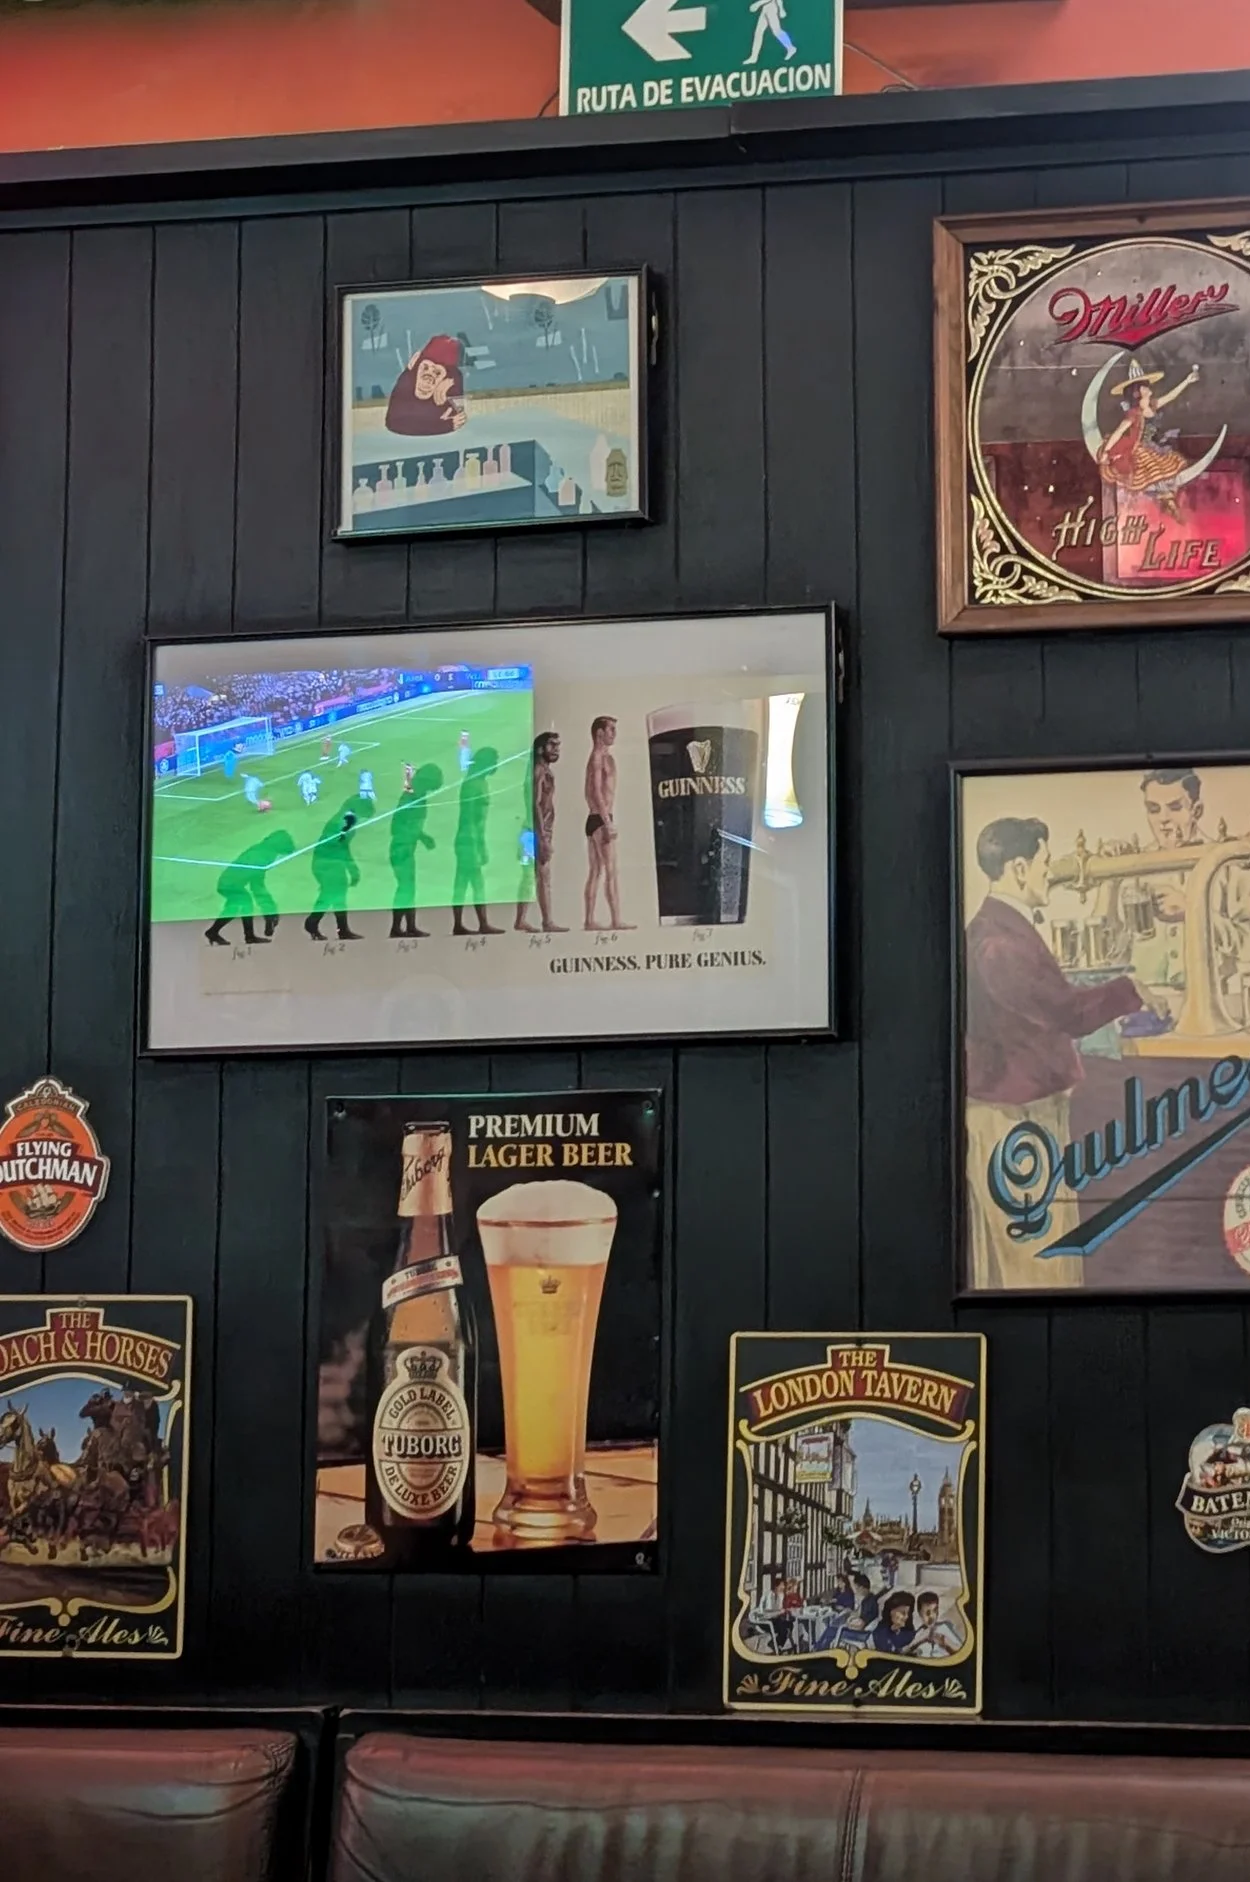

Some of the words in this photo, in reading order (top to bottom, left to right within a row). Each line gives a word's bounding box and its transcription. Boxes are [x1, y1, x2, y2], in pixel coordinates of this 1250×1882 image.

[577, 83, 637, 113] RUTA
[643, 79, 673, 107] DE
[680, 63, 831, 104] EVACUACION
[1049, 283, 1230, 345] Miller
[1052, 496, 1147, 561] HIGH
[1138, 522, 1222, 572] LIFE
[658, 775, 747, 798] GUINNESS
[550, 955, 641, 974] GUINNESS.
[645, 952, 692, 970] PURE
[696, 949, 767, 968] GENIUS.
[16, 1098, 77, 1112] CALEDONIAN
[468, 1113, 600, 1138] PREMIUM
[17, 1141, 73, 1157] FLYING
[467, 1143, 555, 1168] LAGER
[562, 1142, 634, 1167] BEER
[0, 1157, 98, 1187] UTCHMAN
[59, 1312, 92, 1329] THE
[61, 1330, 81, 1360] &
[84, 1330, 173, 1378] HORSES
[839, 1351, 878, 1367] THE
[388, 1388, 417, 1420] GOLD
[420, 1387, 457, 1421] LABEL
[753, 1370, 856, 1417] LONDON
[861, 1369, 958, 1414] TAVERN
[382, 1433, 463, 1459] TUBORG
[385, 1466, 399, 1486] DE
[395, 1486, 430, 1506] LUXE
[431, 1465, 458, 1501] BEER
[78, 1616, 146, 1645] Ales
[762, 1666, 850, 1697] Fine
[854, 1667, 942, 1698] Ales
